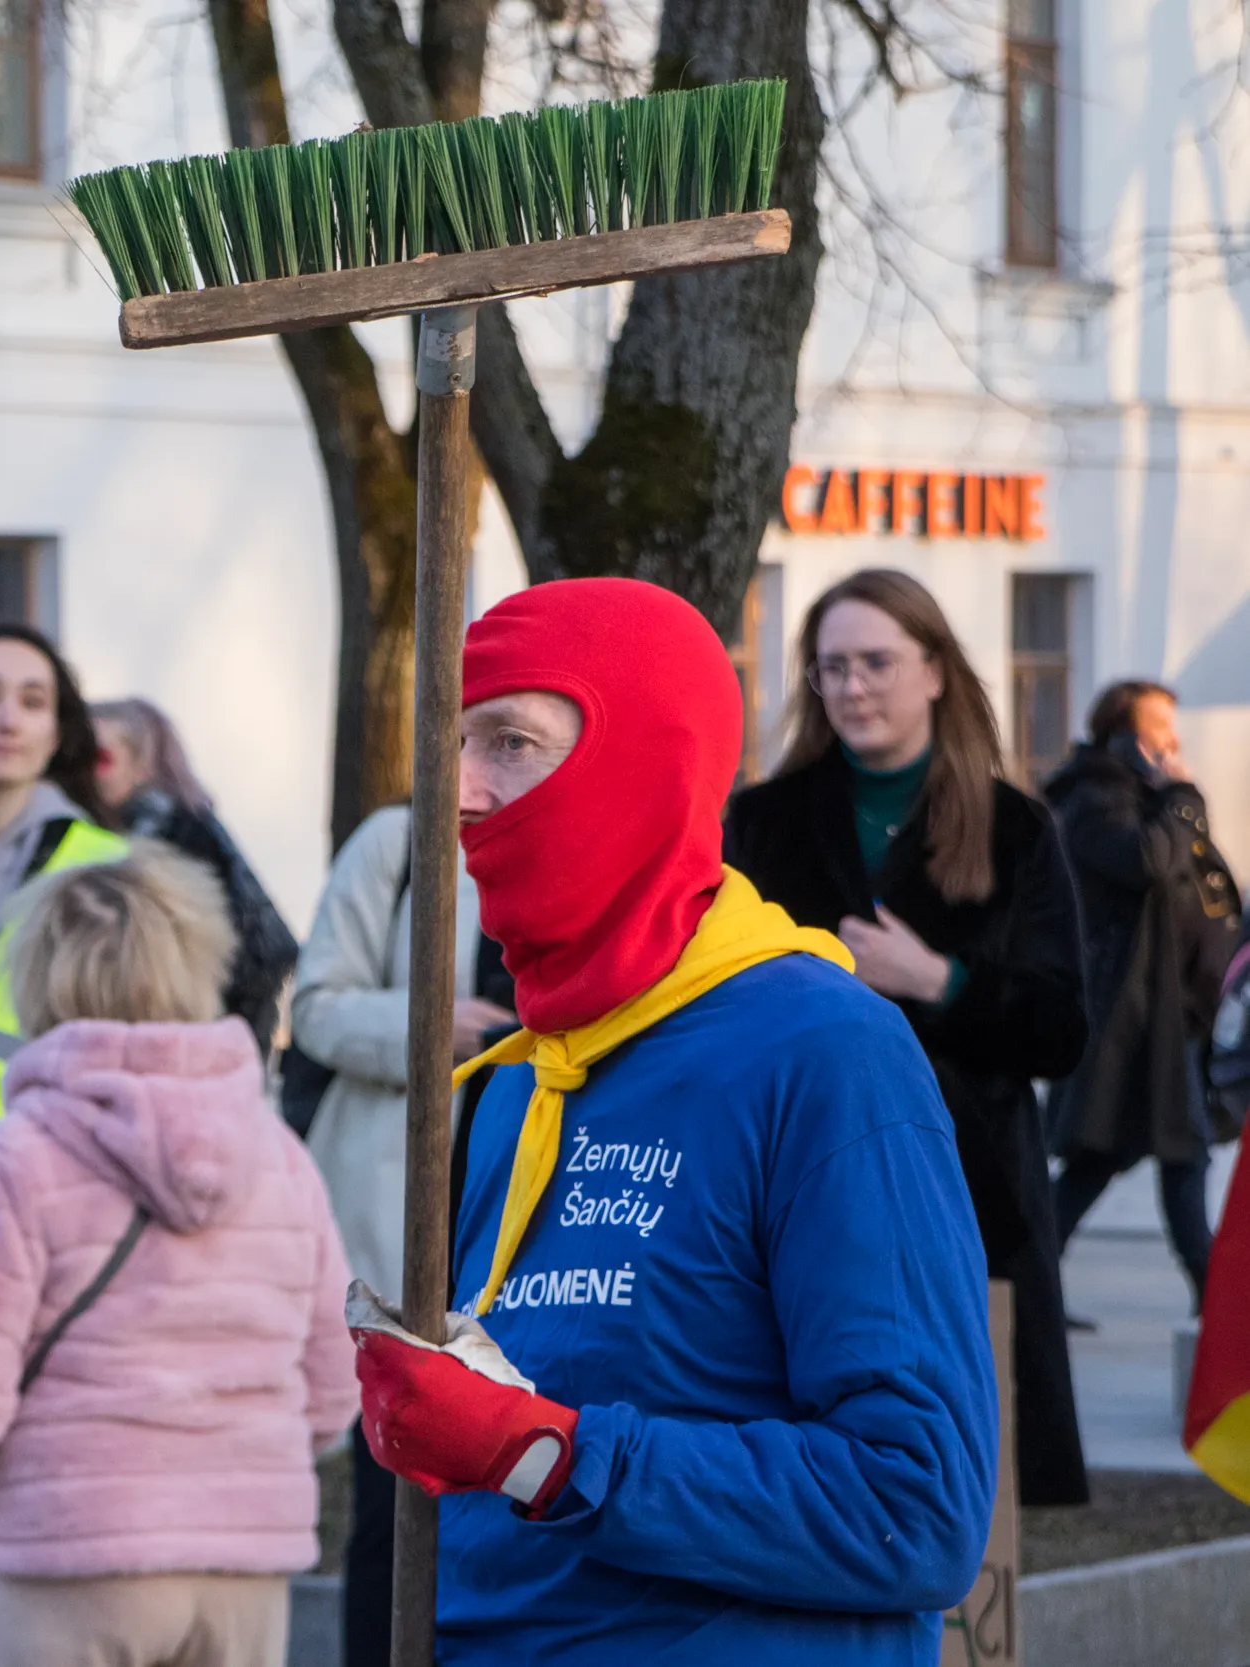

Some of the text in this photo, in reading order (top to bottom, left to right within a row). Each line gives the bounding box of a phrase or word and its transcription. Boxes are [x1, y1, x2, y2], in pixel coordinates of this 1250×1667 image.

[781, 463, 1046, 541] CAFFEINE
[565, 1126, 683, 1188] Žemųjų
[559, 1182, 665, 1237] Šančių
